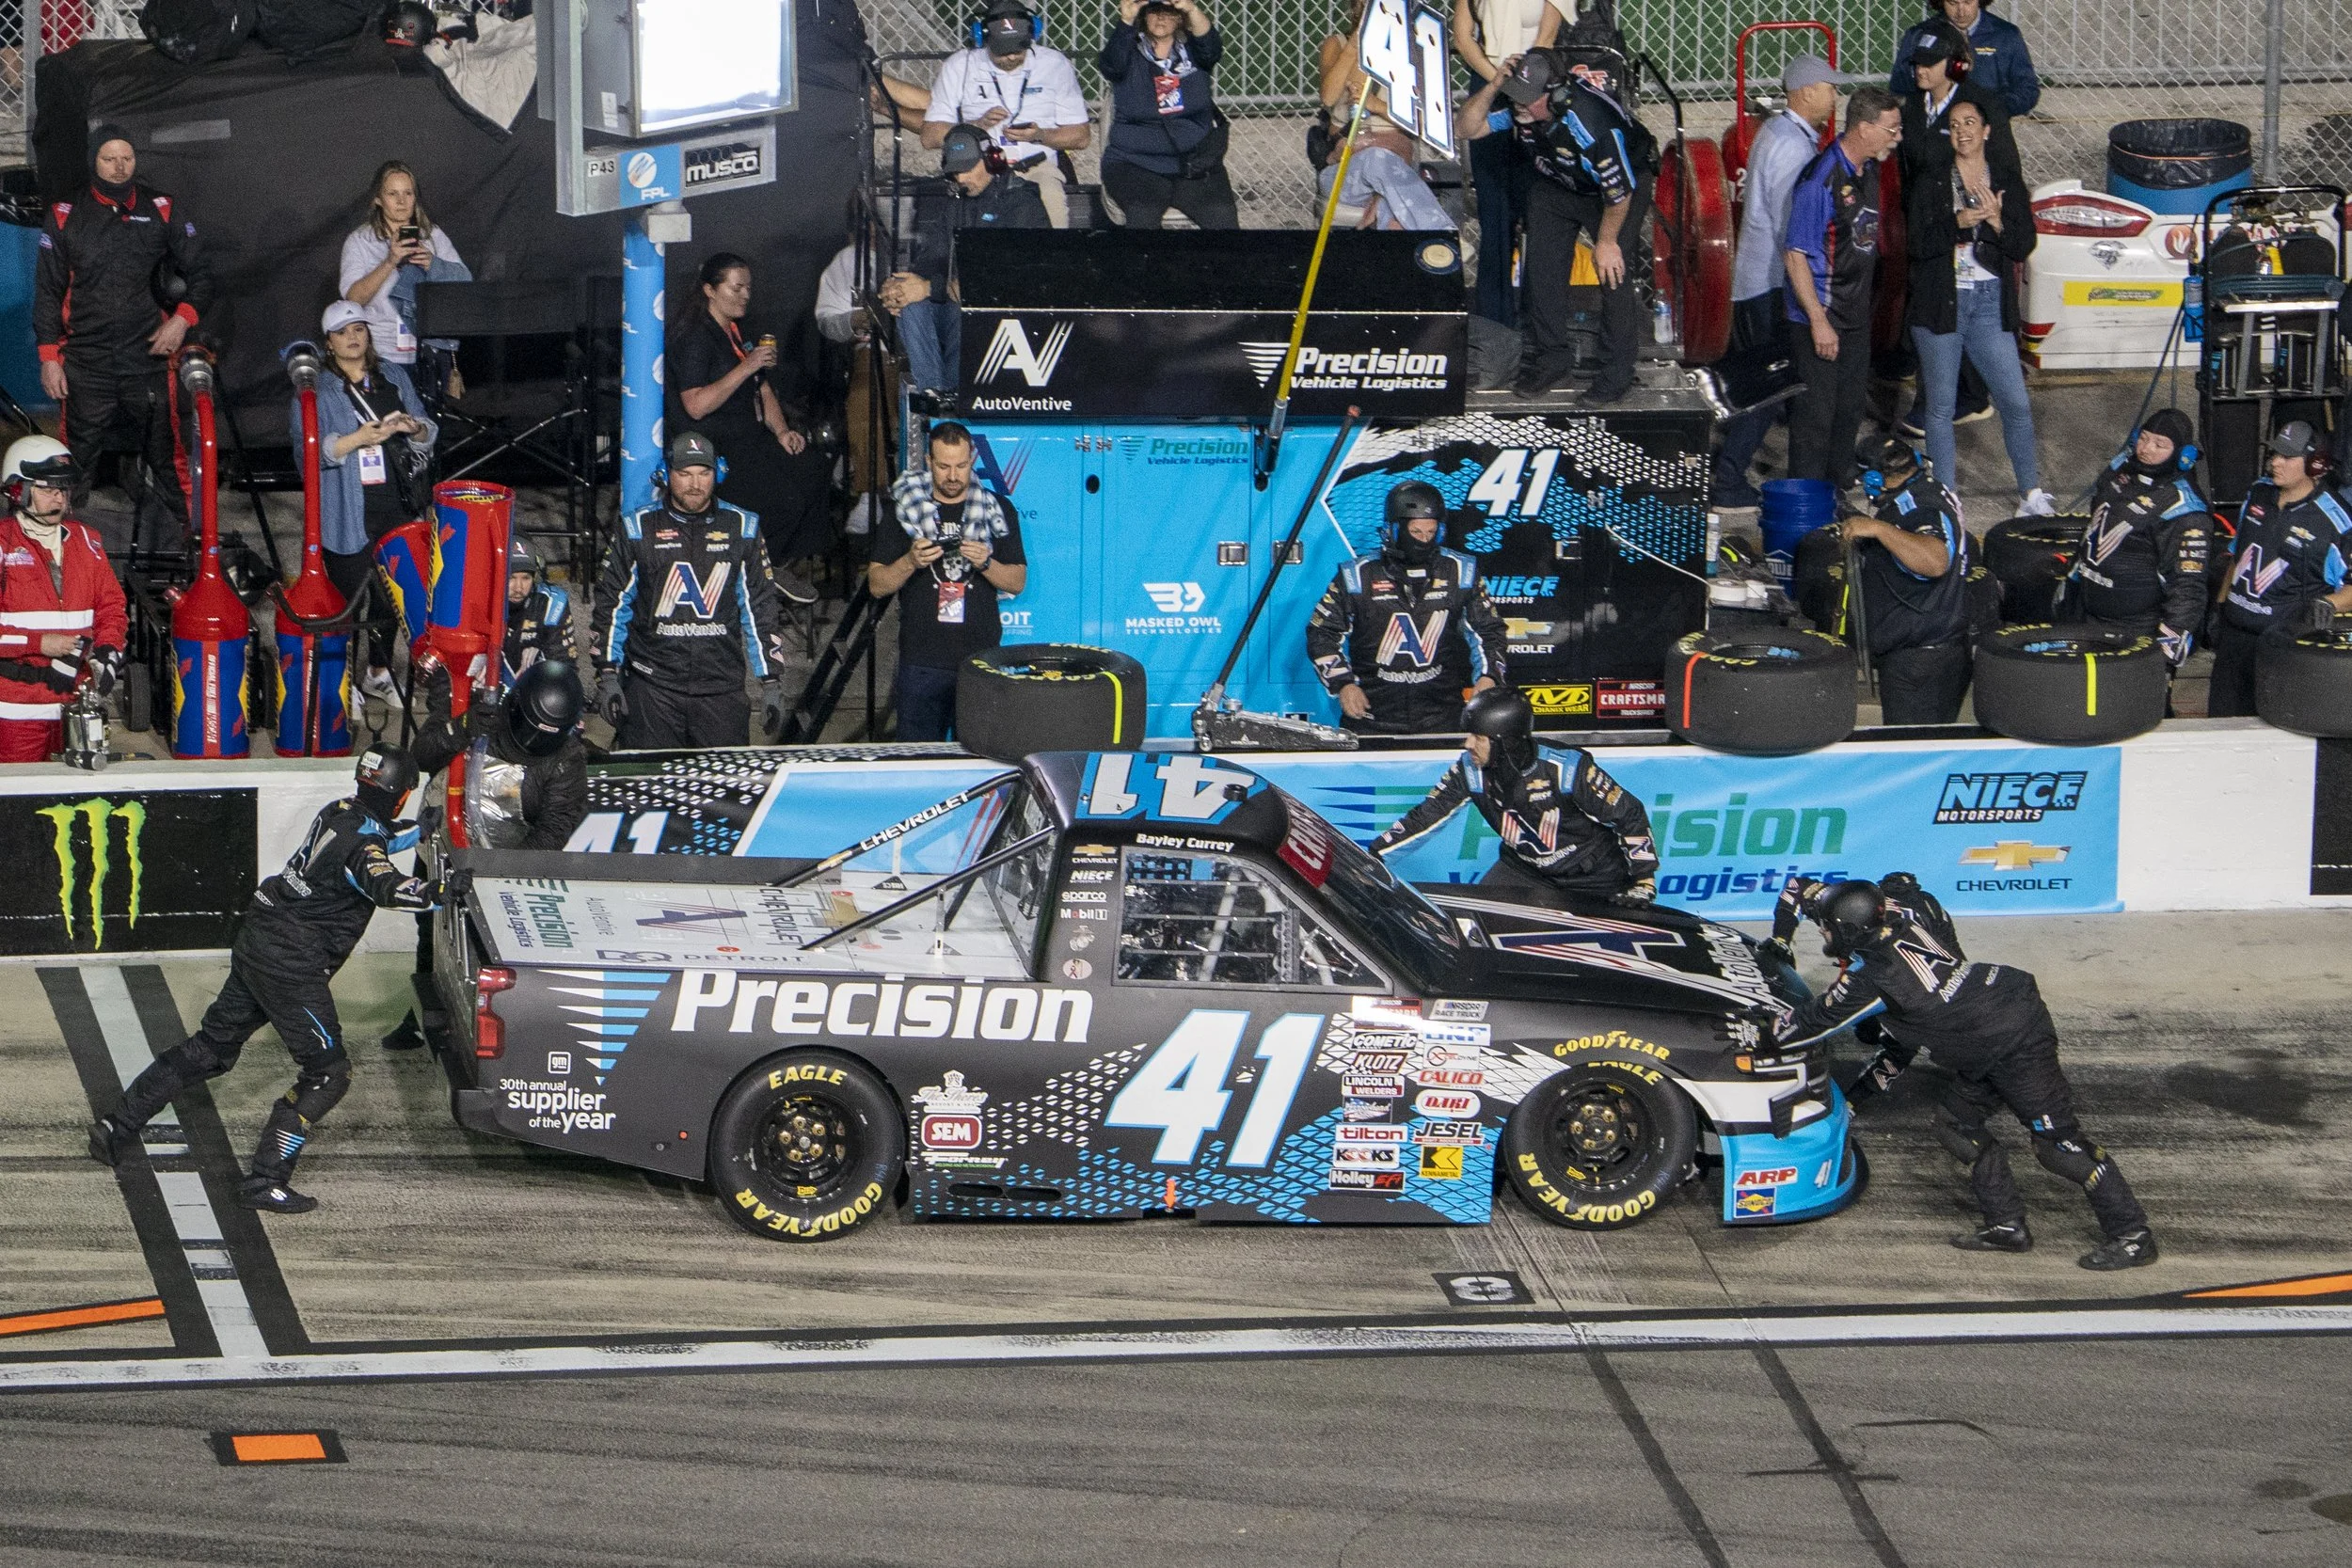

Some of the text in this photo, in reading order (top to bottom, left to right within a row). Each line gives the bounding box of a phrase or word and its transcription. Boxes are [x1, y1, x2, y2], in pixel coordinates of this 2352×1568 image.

[1360, 0, 1453, 154] 41
[641, 187, 672, 200] FPL
[1294, 347, 1448, 374] Precision
[1291, 376, 1448, 391] Vehicle Logistics
[973, 396, 1073, 411] AutoVentive
[1152, 438, 1248, 455] Precision
[1148, 457, 1248, 467] Vehicle Logistics
[1469, 448, 1562, 516] 41
[1483, 576, 1560, 596] NIECE
[1125, 616, 1221, 627] MASKED OWL
[1600, 694, 1665, 705] CRAFTSMA
[1940, 771, 2088, 810] NIECE
[860, 790, 970, 850] CHEVROLET
[1937, 809, 2042, 822] MOTORSPORTS
[1136, 833, 1234, 852] Bayley Currey
[1071, 870, 1114, 880] NIECE
[1957, 879, 2073, 892] CHEVROLET
[524, 893, 580, 948] Precision
[1061, 909, 1094, 920] Mobil
[684, 954, 806, 962] DETROIT
[671, 968, 1093, 1043] Precision
[1353, 1034, 1418, 1049] COMETIC
[1554, 1030, 1670, 1060] GOODYEAR
[552, 1056, 566, 1069] gm
[1355, 1054, 1405, 1069] KLOTZ
[500, 1079, 566, 1091] 30th annual
[769, 1065, 848, 1089] EAGLE
[1345, 1076, 1393, 1086] LINCOLN
[1420, 1071, 1484, 1085] CALICO
[1104, 1008, 1325, 1168] 41
[508, 1087, 606, 1114] supplier
[529, 1112, 616, 1133] of the year
[1416, 1122, 1484, 1137] JESEL
[931, 1122, 971, 1141] SEM
[1341, 1128, 1403, 1139] tilton
[1336, 1149, 1395, 1162] KOOKS
[1331, 1170, 1375, 1187] Holley
[1737, 1168, 1796, 1185] ARP
[1814, 1159, 1833, 1188] 41
[1518, 1153, 1656, 1223] GOODYEAR
[736, 1182, 882, 1237] GOODYEAR
[1737, 1196, 1774, 1209] SUNOCO
